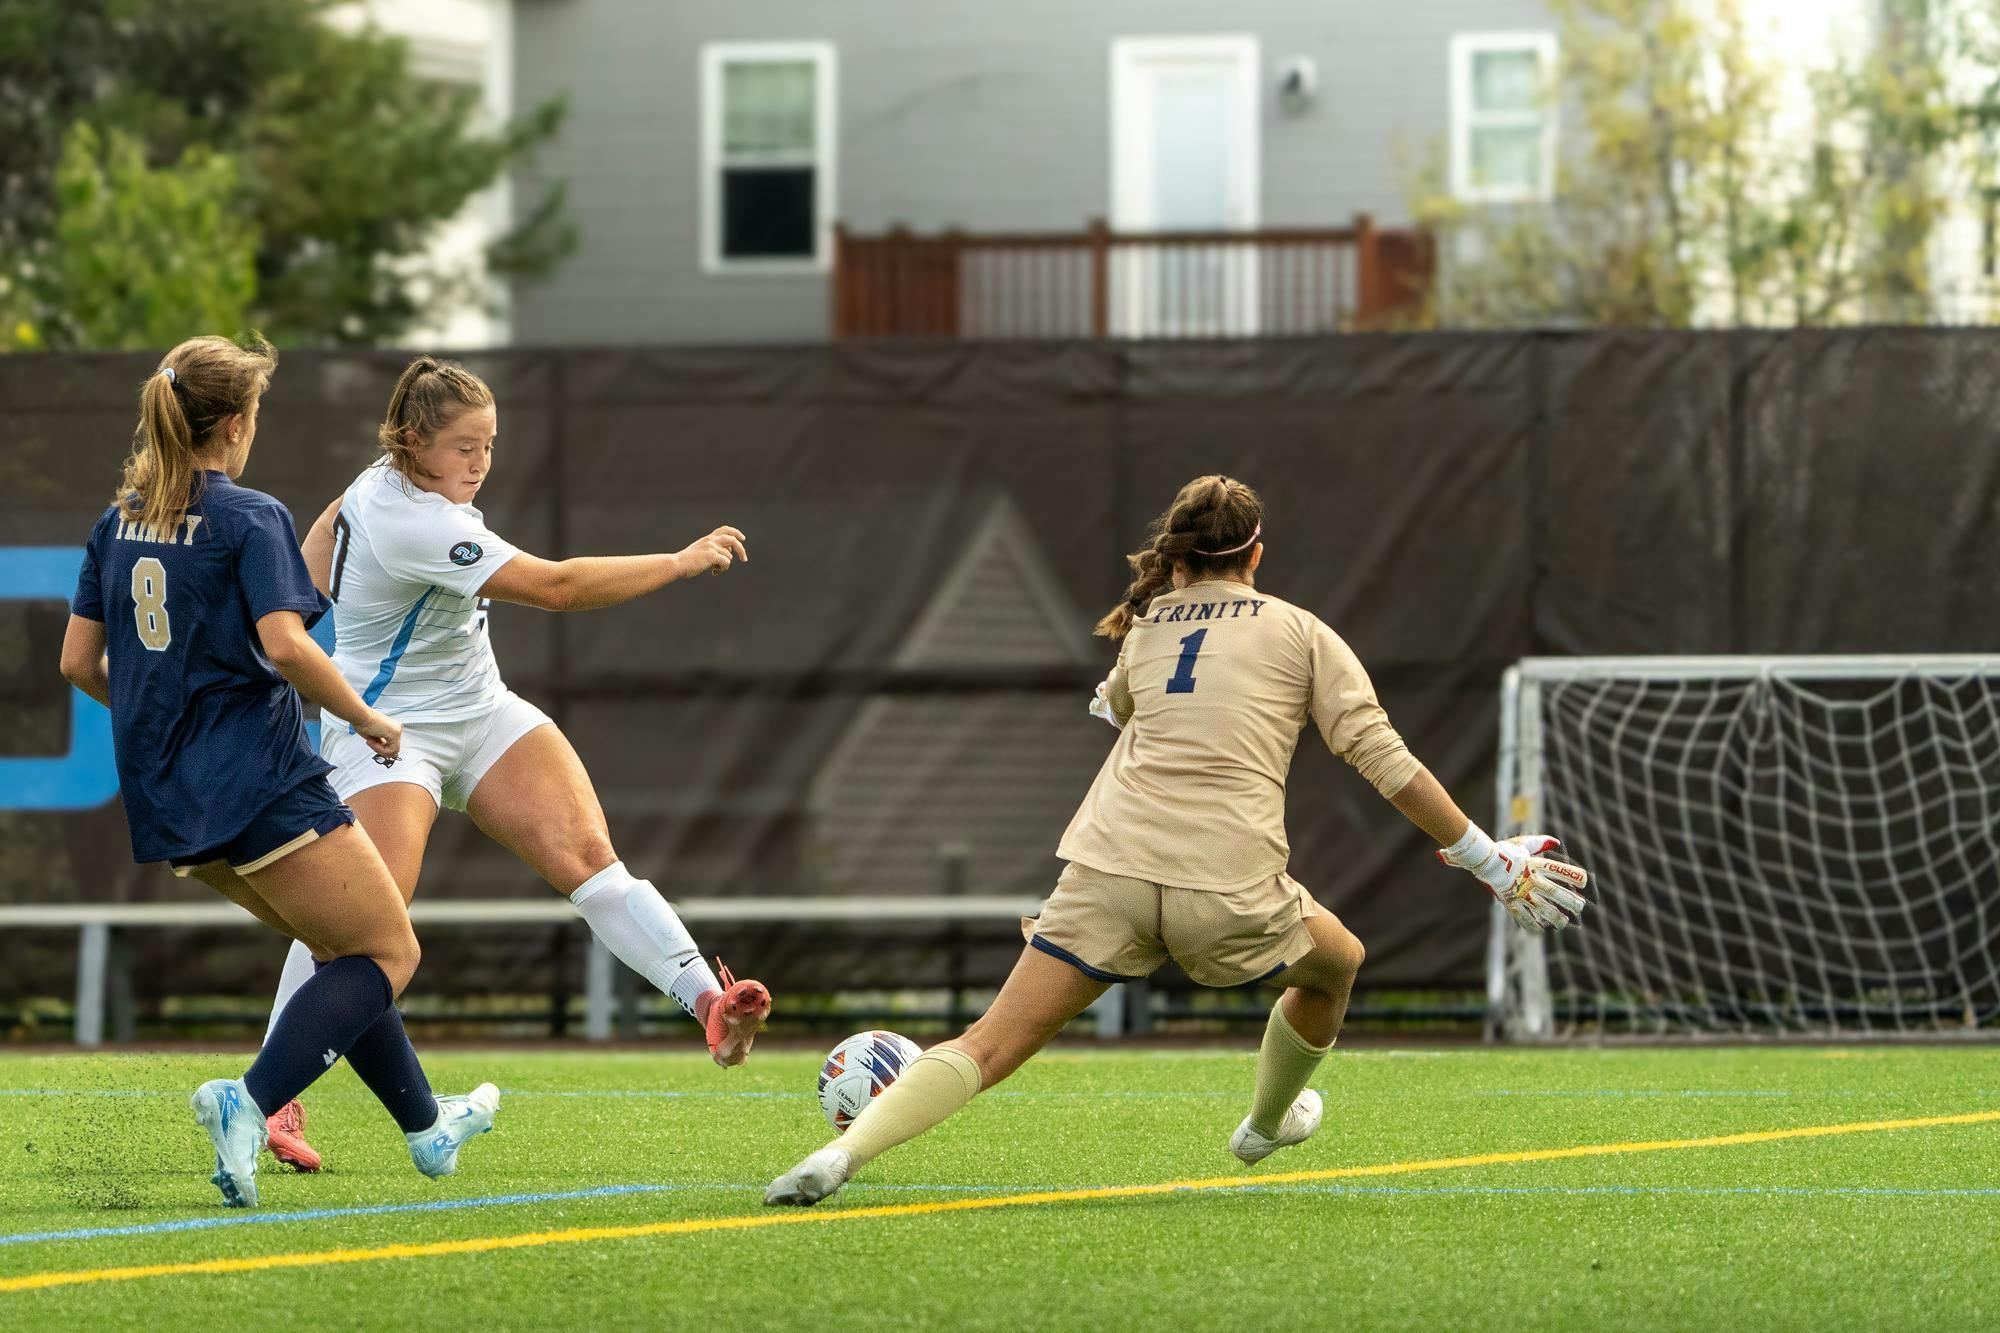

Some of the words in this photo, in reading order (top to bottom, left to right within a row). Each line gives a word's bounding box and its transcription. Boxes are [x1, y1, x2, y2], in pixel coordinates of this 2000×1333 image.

[116, 511, 203, 546] TRINY
[131, 556, 171, 651] 8
[1153, 600, 1267, 623] TRINITY
[1166, 628, 1208, 694] 1
[1544, 862, 1584, 881] reusch
